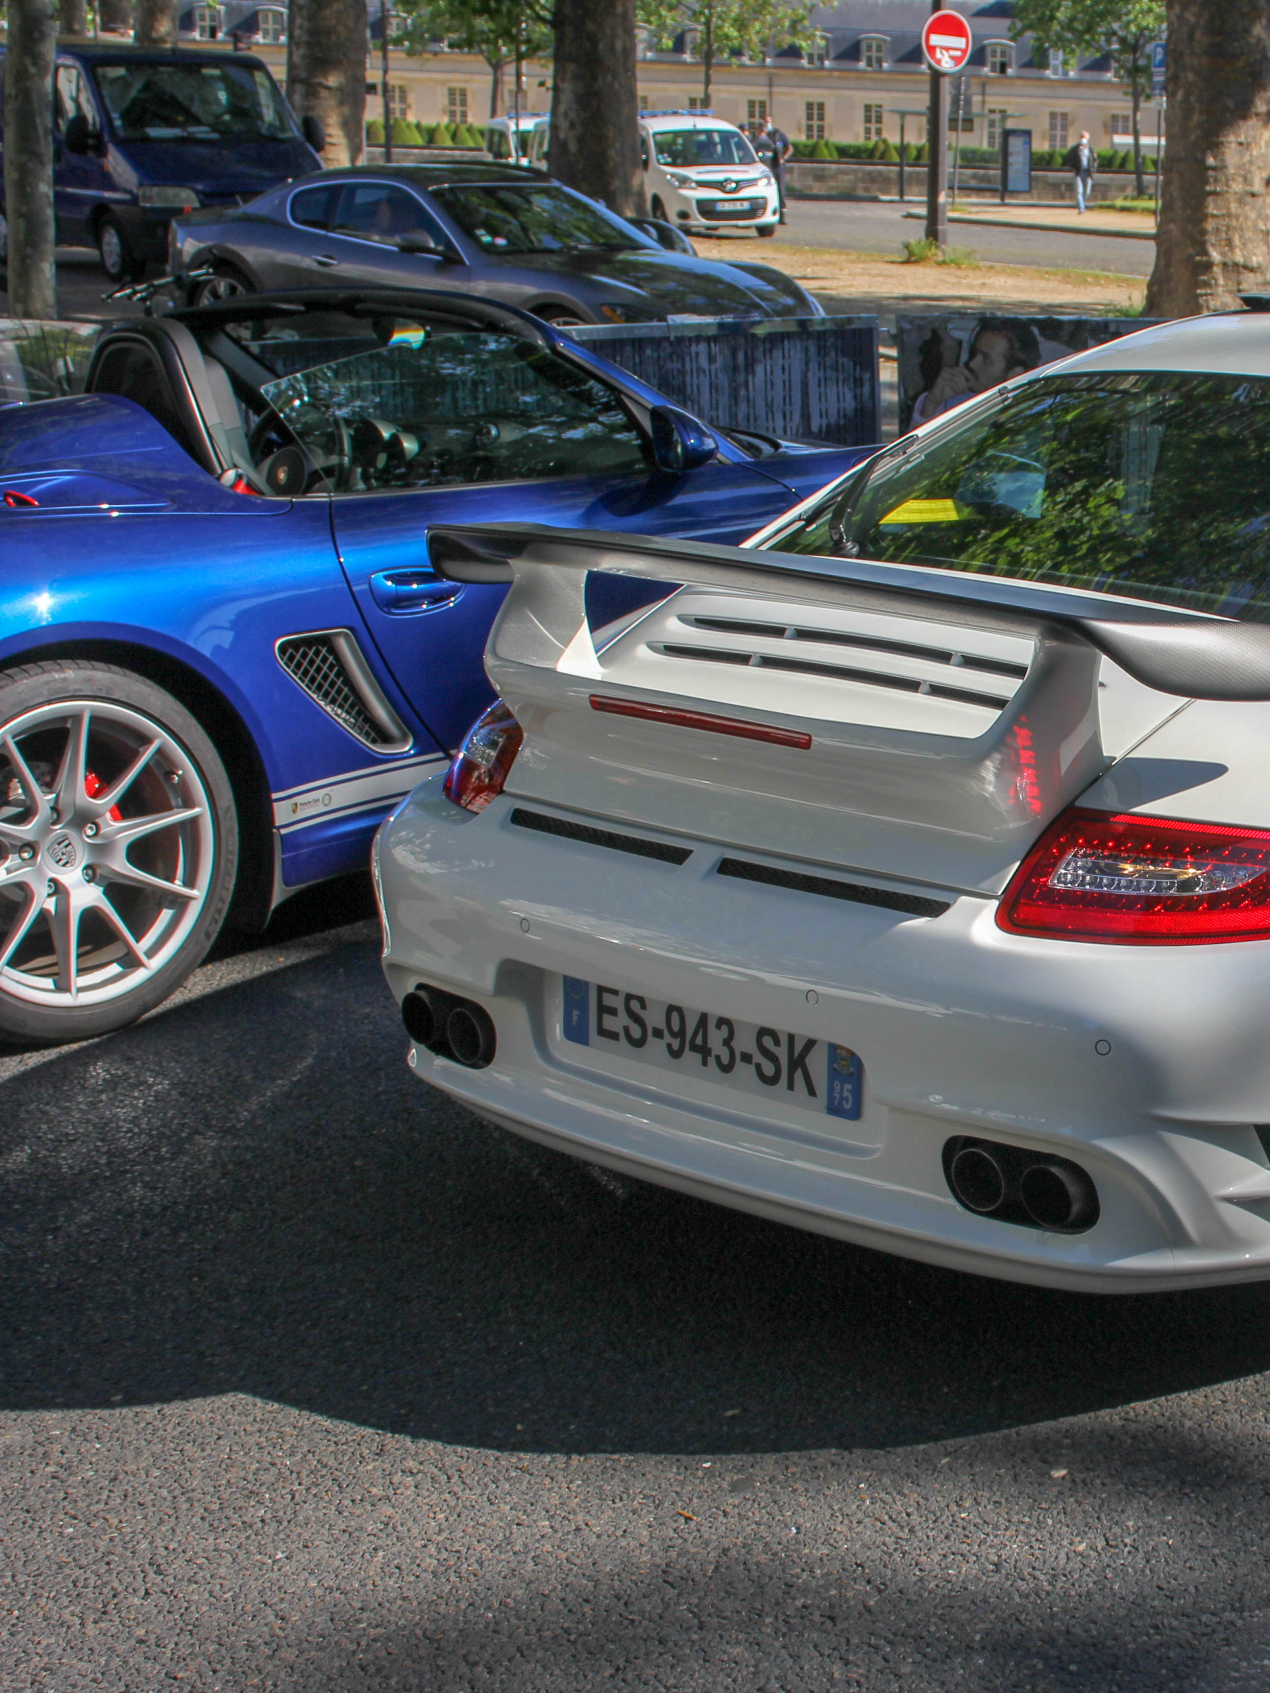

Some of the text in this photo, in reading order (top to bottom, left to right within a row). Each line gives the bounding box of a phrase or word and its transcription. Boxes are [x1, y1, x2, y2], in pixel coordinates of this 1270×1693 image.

[1155, 46, 1164, 65] P
[571, 1010, 580, 1026] F
[596, 983, 819, 1099] ES-943-SK
